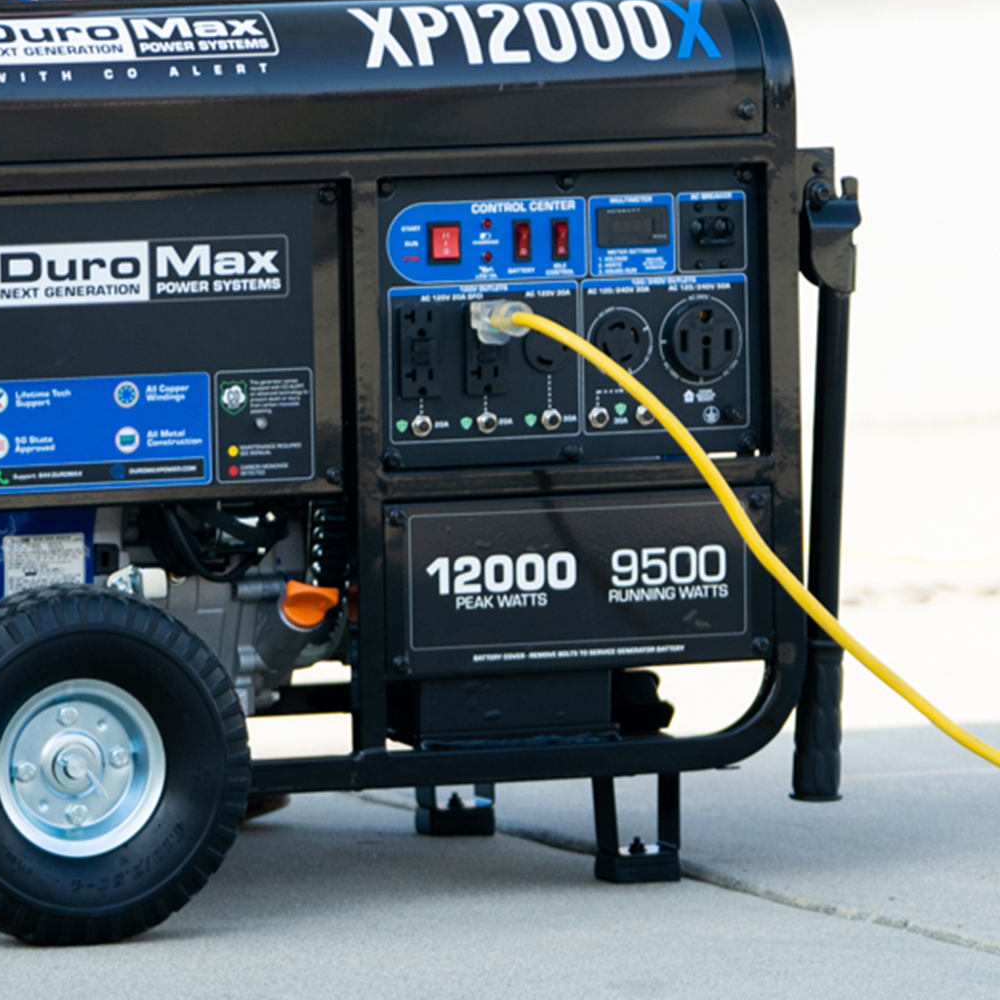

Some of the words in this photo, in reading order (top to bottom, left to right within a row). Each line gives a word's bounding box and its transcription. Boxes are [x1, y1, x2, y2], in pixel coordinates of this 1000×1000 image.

[346, 0, 722, 69] XP12000X
[24, 43, 123, 56] GENERATION
[139, 41, 195, 54] POWER
[198, 37, 269, 52] SYSTEMS
[103, 67, 138, 80] CO
[169, 62, 268, 77] ALERT
[471, 202, 527, 214] CONTROL
[529, 200, 576, 211] CENTER
[0, 287, 40, 299] NEXT
[44, 283, 141, 298] GENERATION
[156, 280, 209, 294] POWER
[213, 278, 282, 292] SYSTEMS
[15, 389, 50, 399] Lifetime
[52, 388, 72, 398] Tech
[159, 384, 190, 394] Copper
[15, 399, 51, 409] Support
[145, 393, 186, 402] Windings
[29, 435, 54, 444] State
[160, 428, 186, 438] Metal
[15, 443, 56, 454] Approved
[146, 437, 203, 447] Construction
[425, 551, 577, 595] 12000
[611, 544, 727, 588] 9500
[608, 587, 676, 603] RUNNING
[679, 583, 729, 598] WATTS
[455, 595, 493, 610] PEAK
[497, 592, 548, 608] WATTS
[473, 654, 501, 662] BATTERY
[503, 652, 525, 661] COVER
[558, 650, 578, 658] BOLTS
[580, 649, 588, 657] TO
[589, 648, 616, 656] SERVICE
[617, 646, 655, 655] GENERATOR
[656, 644, 685, 653] BATTERY
